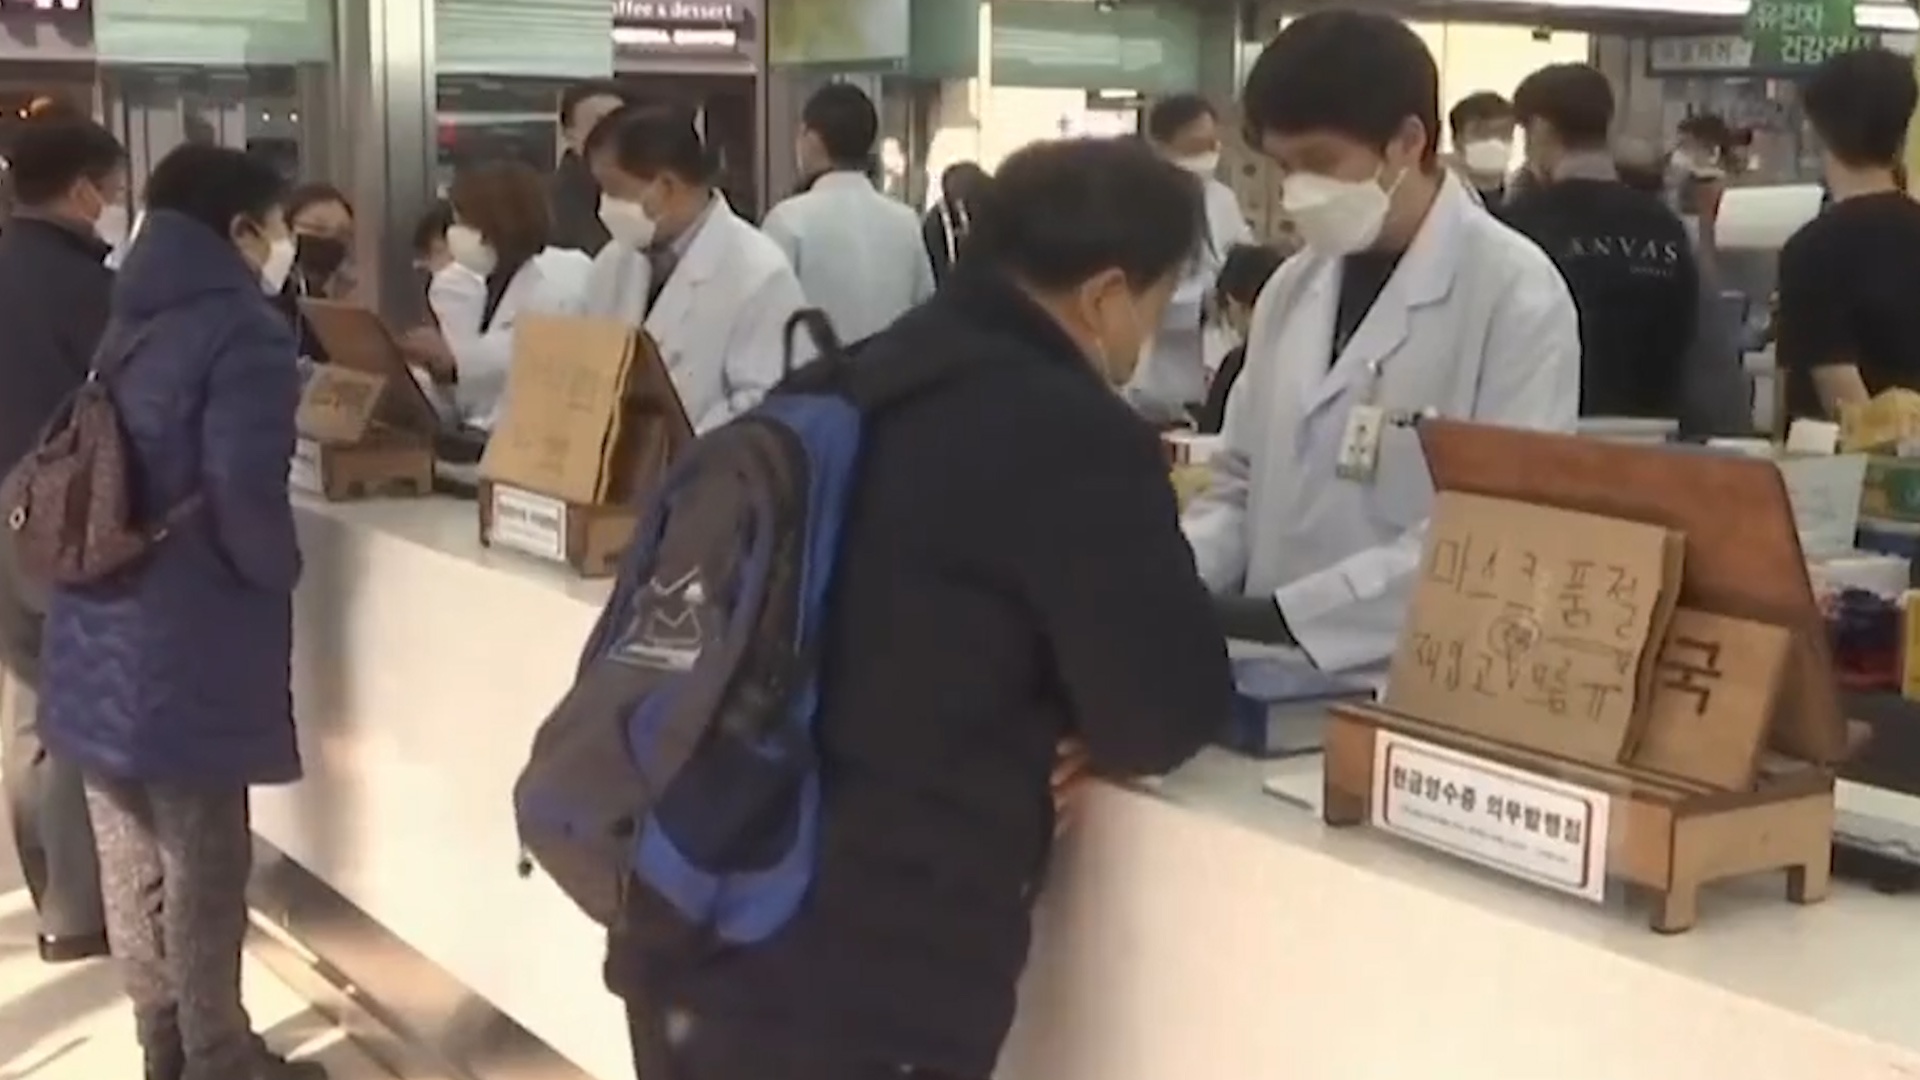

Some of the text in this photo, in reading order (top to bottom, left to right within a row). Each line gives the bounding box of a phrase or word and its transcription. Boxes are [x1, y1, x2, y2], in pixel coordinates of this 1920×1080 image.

[670, 1, 733, 20] dessert
[1756, 2, 1823, 31] 유전자
[1431, 533, 1639, 641] 마스크 품절
[1393, 765, 1477, 812] 현금영수증
